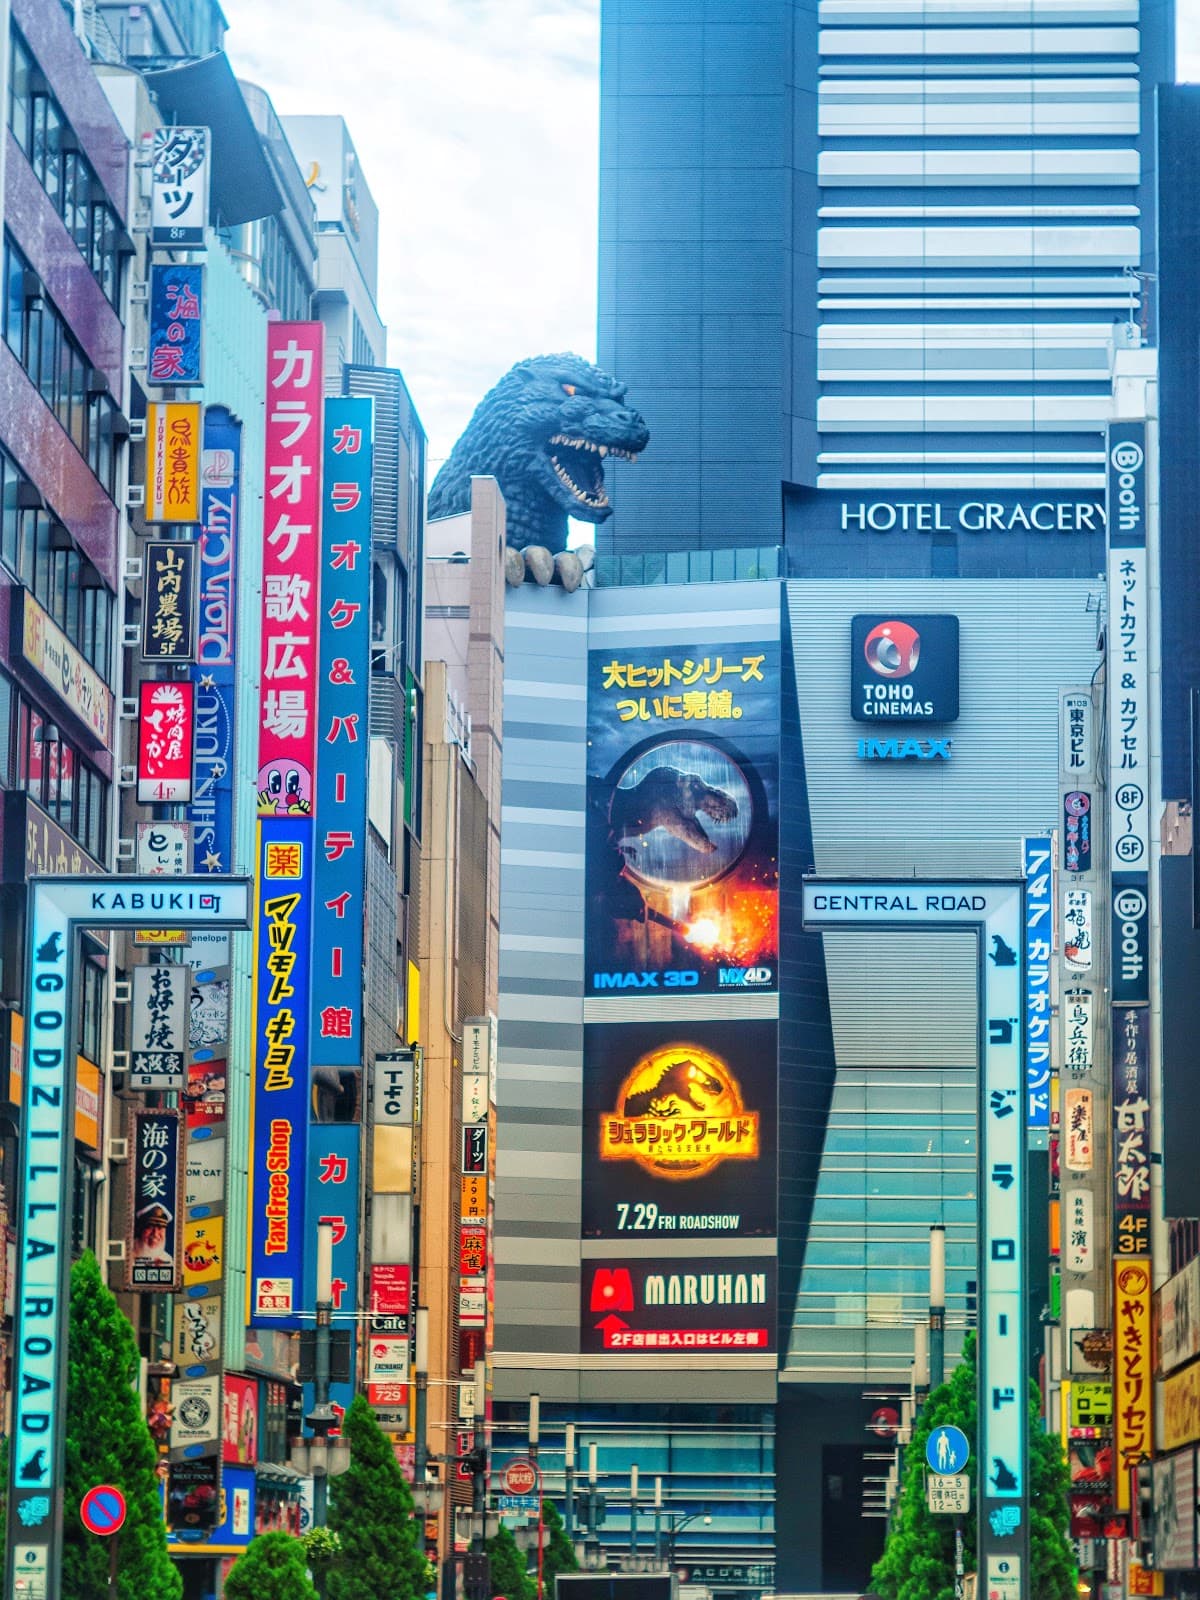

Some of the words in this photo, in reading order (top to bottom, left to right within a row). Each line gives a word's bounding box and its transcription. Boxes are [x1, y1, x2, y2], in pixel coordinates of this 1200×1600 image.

[163, 135, 194, 219] ダーツ
[170, 228, 186, 239] 8F
[152, 283, 200, 379] 海の家
[156, 417, 164, 501] TORIKIZOKU
[1111, 441, 1144, 530] Booth
[841, 503, 951, 530] HOTEL
[262, 340, 313, 740] カラオケ歌広場
[152, 548, 185, 642] 山内農場
[1119, 559, 1137, 663] ネットカフェ
[160, 642, 176, 655] 5F
[602, 655, 765, 690] 大ヒットシリーズ
[1120, 673, 1137, 688] &
[615, 689, 743, 722] ついに完結。
[863, 684, 914, 700] TOHO
[863, 701, 934, 716] CINEMAS
[144, 709, 166, 775] さかい
[165, 704, 187, 761] 焼肉屋
[857, 737, 951, 760] IMAX
[1069, 709, 1085, 768] 東京ビル
[1120, 698, 1138, 769] カプセル
[152, 781, 176, 800] 4F
[268, 845, 299, 876] 薬
[92, 893, 221, 913] KABUKI町
[814, 895, 918, 911] CENTRAL
[926, 895, 987, 911] ROAD
[1028, 850, 1051, 927] 747
[191, 934, 227, 943] enelope
[1114, 889, 1147, 980] Booth
[264, 893, 302, 1091] マツモトキヨシ
[593, 973, 659, 990] IMAX
[663, 970, 700, 988] 3D
[719, 967, 772, 985] MX4D
[146, 968, 174, 1050] お好み焼
[1028, 938, 1051, 1117] カラオケランド
[134, 1053, 181, 1074] 大阪家
[1124, 1010, 1138, 1094] 手作り居酒屋
[26, 973, 64, 1260] GODZILLA
[608, 1119, 750, 1145] ジュラシック・ワールド
[142, 1122, 169, 1199] 海の家
[267, 1119, 292, 1171] Shop
[472, 1128, 485, 1163] ダーツ
[1114, 1097, 1150, 1201] 甘太郎
[203, 1169, 222, 1177] CAT
[266, 1174, 290, 1217] Free
[616, 1203, 658, 1230] 7.29
[658, 1215, 676, 1230] FRI
[679, 1215, 740, 1230] ROADSHOW
[989, 1018, 1018, 1410] ゴジラロード
[1118, 1213, 1148, 1233] 4F
[195, 1230, 206, 1239] 3F
[265, 1217, 290, 1256] Tax
[1118, 1234, 1148, 1254] 3F
[463, 1237, 482, 1269] 麻雀
[262, 1296, 287, 1308] 免税
[645, 1274, 767, 1305] MARUHAN
[21, 1297, 54, 1434] ROAD
[375, 1390, 402, 1401] 729
